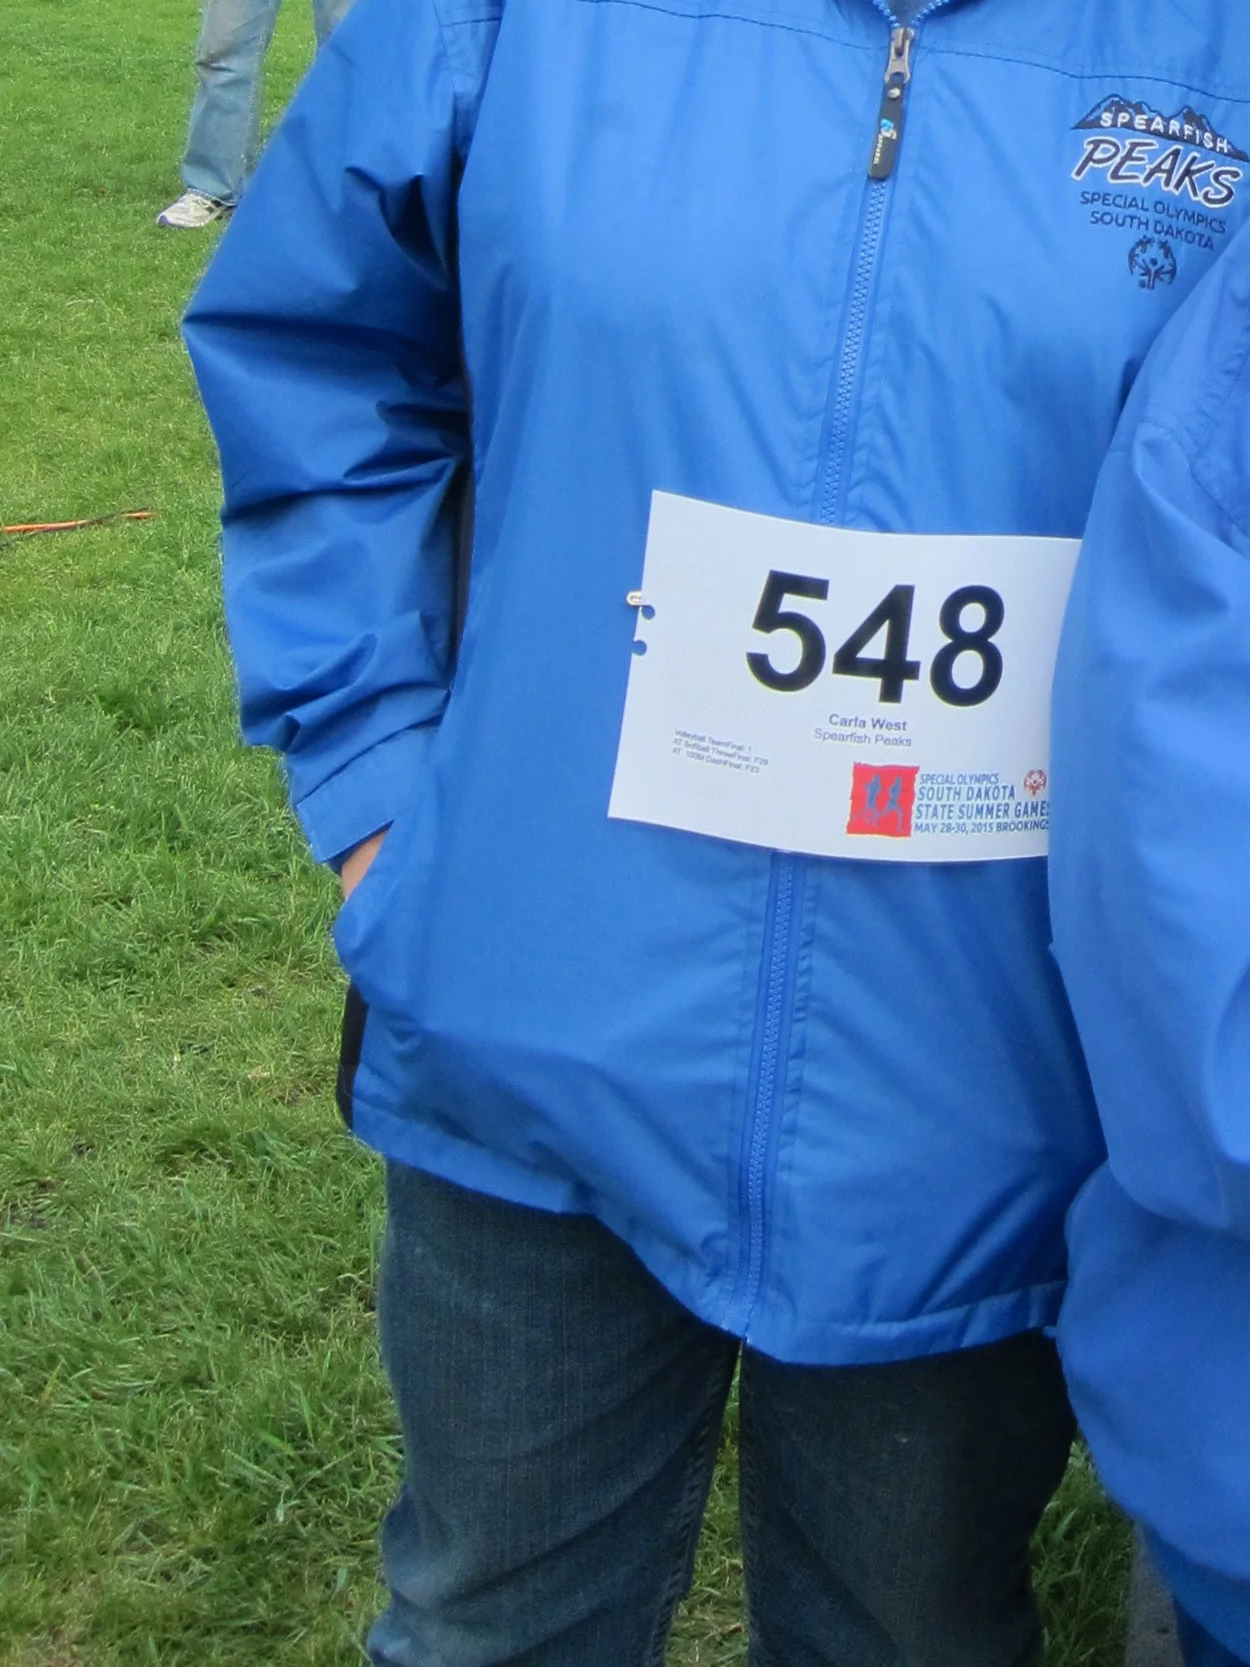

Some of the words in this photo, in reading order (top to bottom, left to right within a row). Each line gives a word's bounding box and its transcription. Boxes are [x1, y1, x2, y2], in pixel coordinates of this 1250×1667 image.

[1099, 111, 1229, 154] SPEARFISH
[1071, 135, 1243, 208] PEAKS
[1080, 190, 1149, 213] SPECIAL
[1153, 201, 1227, 235] OLYMPICS
[1089, 210, 1149, 232] SOUTH
[1153, 219, 1214, 251] DAKOTA
[745, 569, 1006, 708] 548
[828, 713, 867, 729] Carla
[871, 717, 908, 731] West
[814, 728, 871, 745] Spearfish
[875, 734, 912, 747] Peaks
[919, 773, 955, 785] SPECIAL
[957, 772, 1000, 785] OLYMPICS
[917, 785, 962, 802] SOUTH
[966, 784, 1016, 801] DAKOTA
[914, 803, 955, 820] STATE
[957, 802, 1011, 820] SUMMER
[914, 822, 938, 833] MAY
[971, 822, 994, 833] 2015
